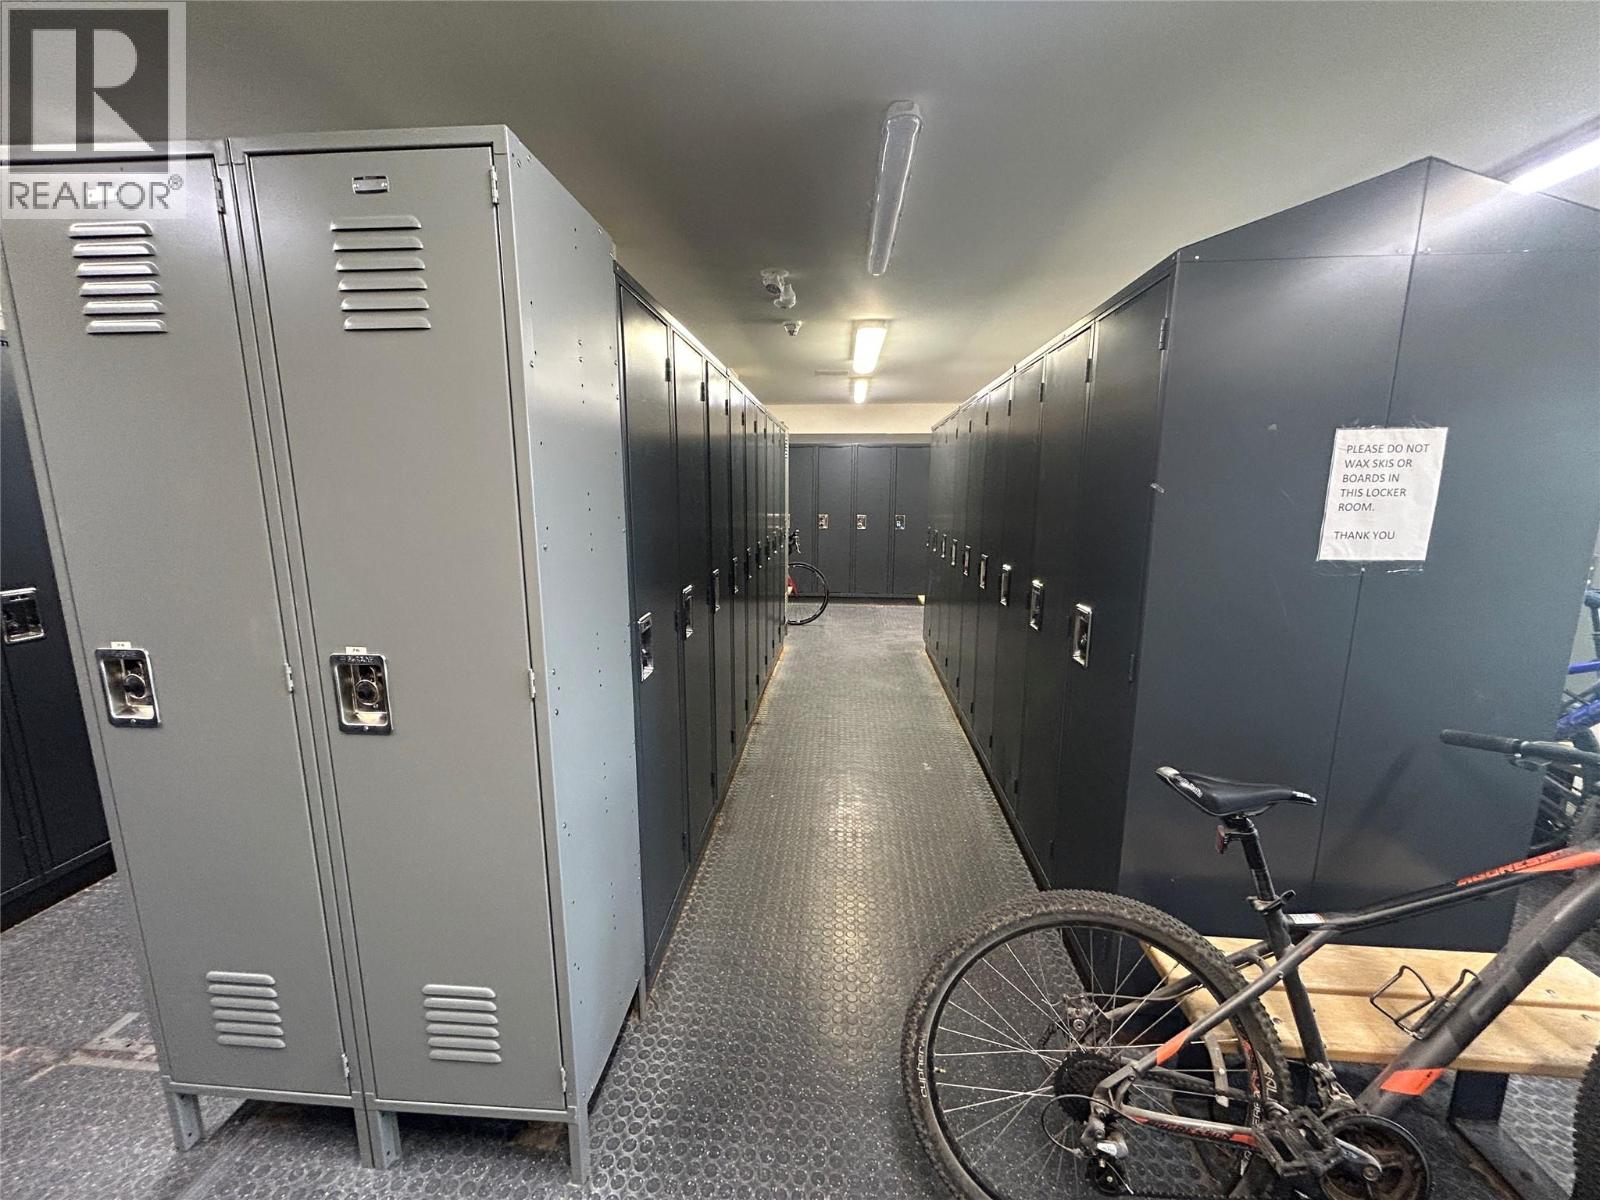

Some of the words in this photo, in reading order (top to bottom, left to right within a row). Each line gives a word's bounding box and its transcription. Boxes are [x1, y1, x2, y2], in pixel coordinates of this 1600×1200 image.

[1346, 444, 1385, 454] PLEASE
[1387, 443, 1403, 454] DO
[1406, 443, 1430, 453] NOT
[1344, 459, 1370, 469] WAX
[1372, 459, 1394, 468] SKIS
[1396, 458, 1413, 468] OR
[1342, 473, 1386, 483] BOARDS
[1388, 473, 1400, 483] IN
[1340, 488, 1363, 498] THIS
[1366, 487, 1407, 498] LOCKER
[1338, 502, 1375, 512] ROOM.
[1334, 530, 1371, 540] THANK
[1372, 530, 1395, 540] YOU
